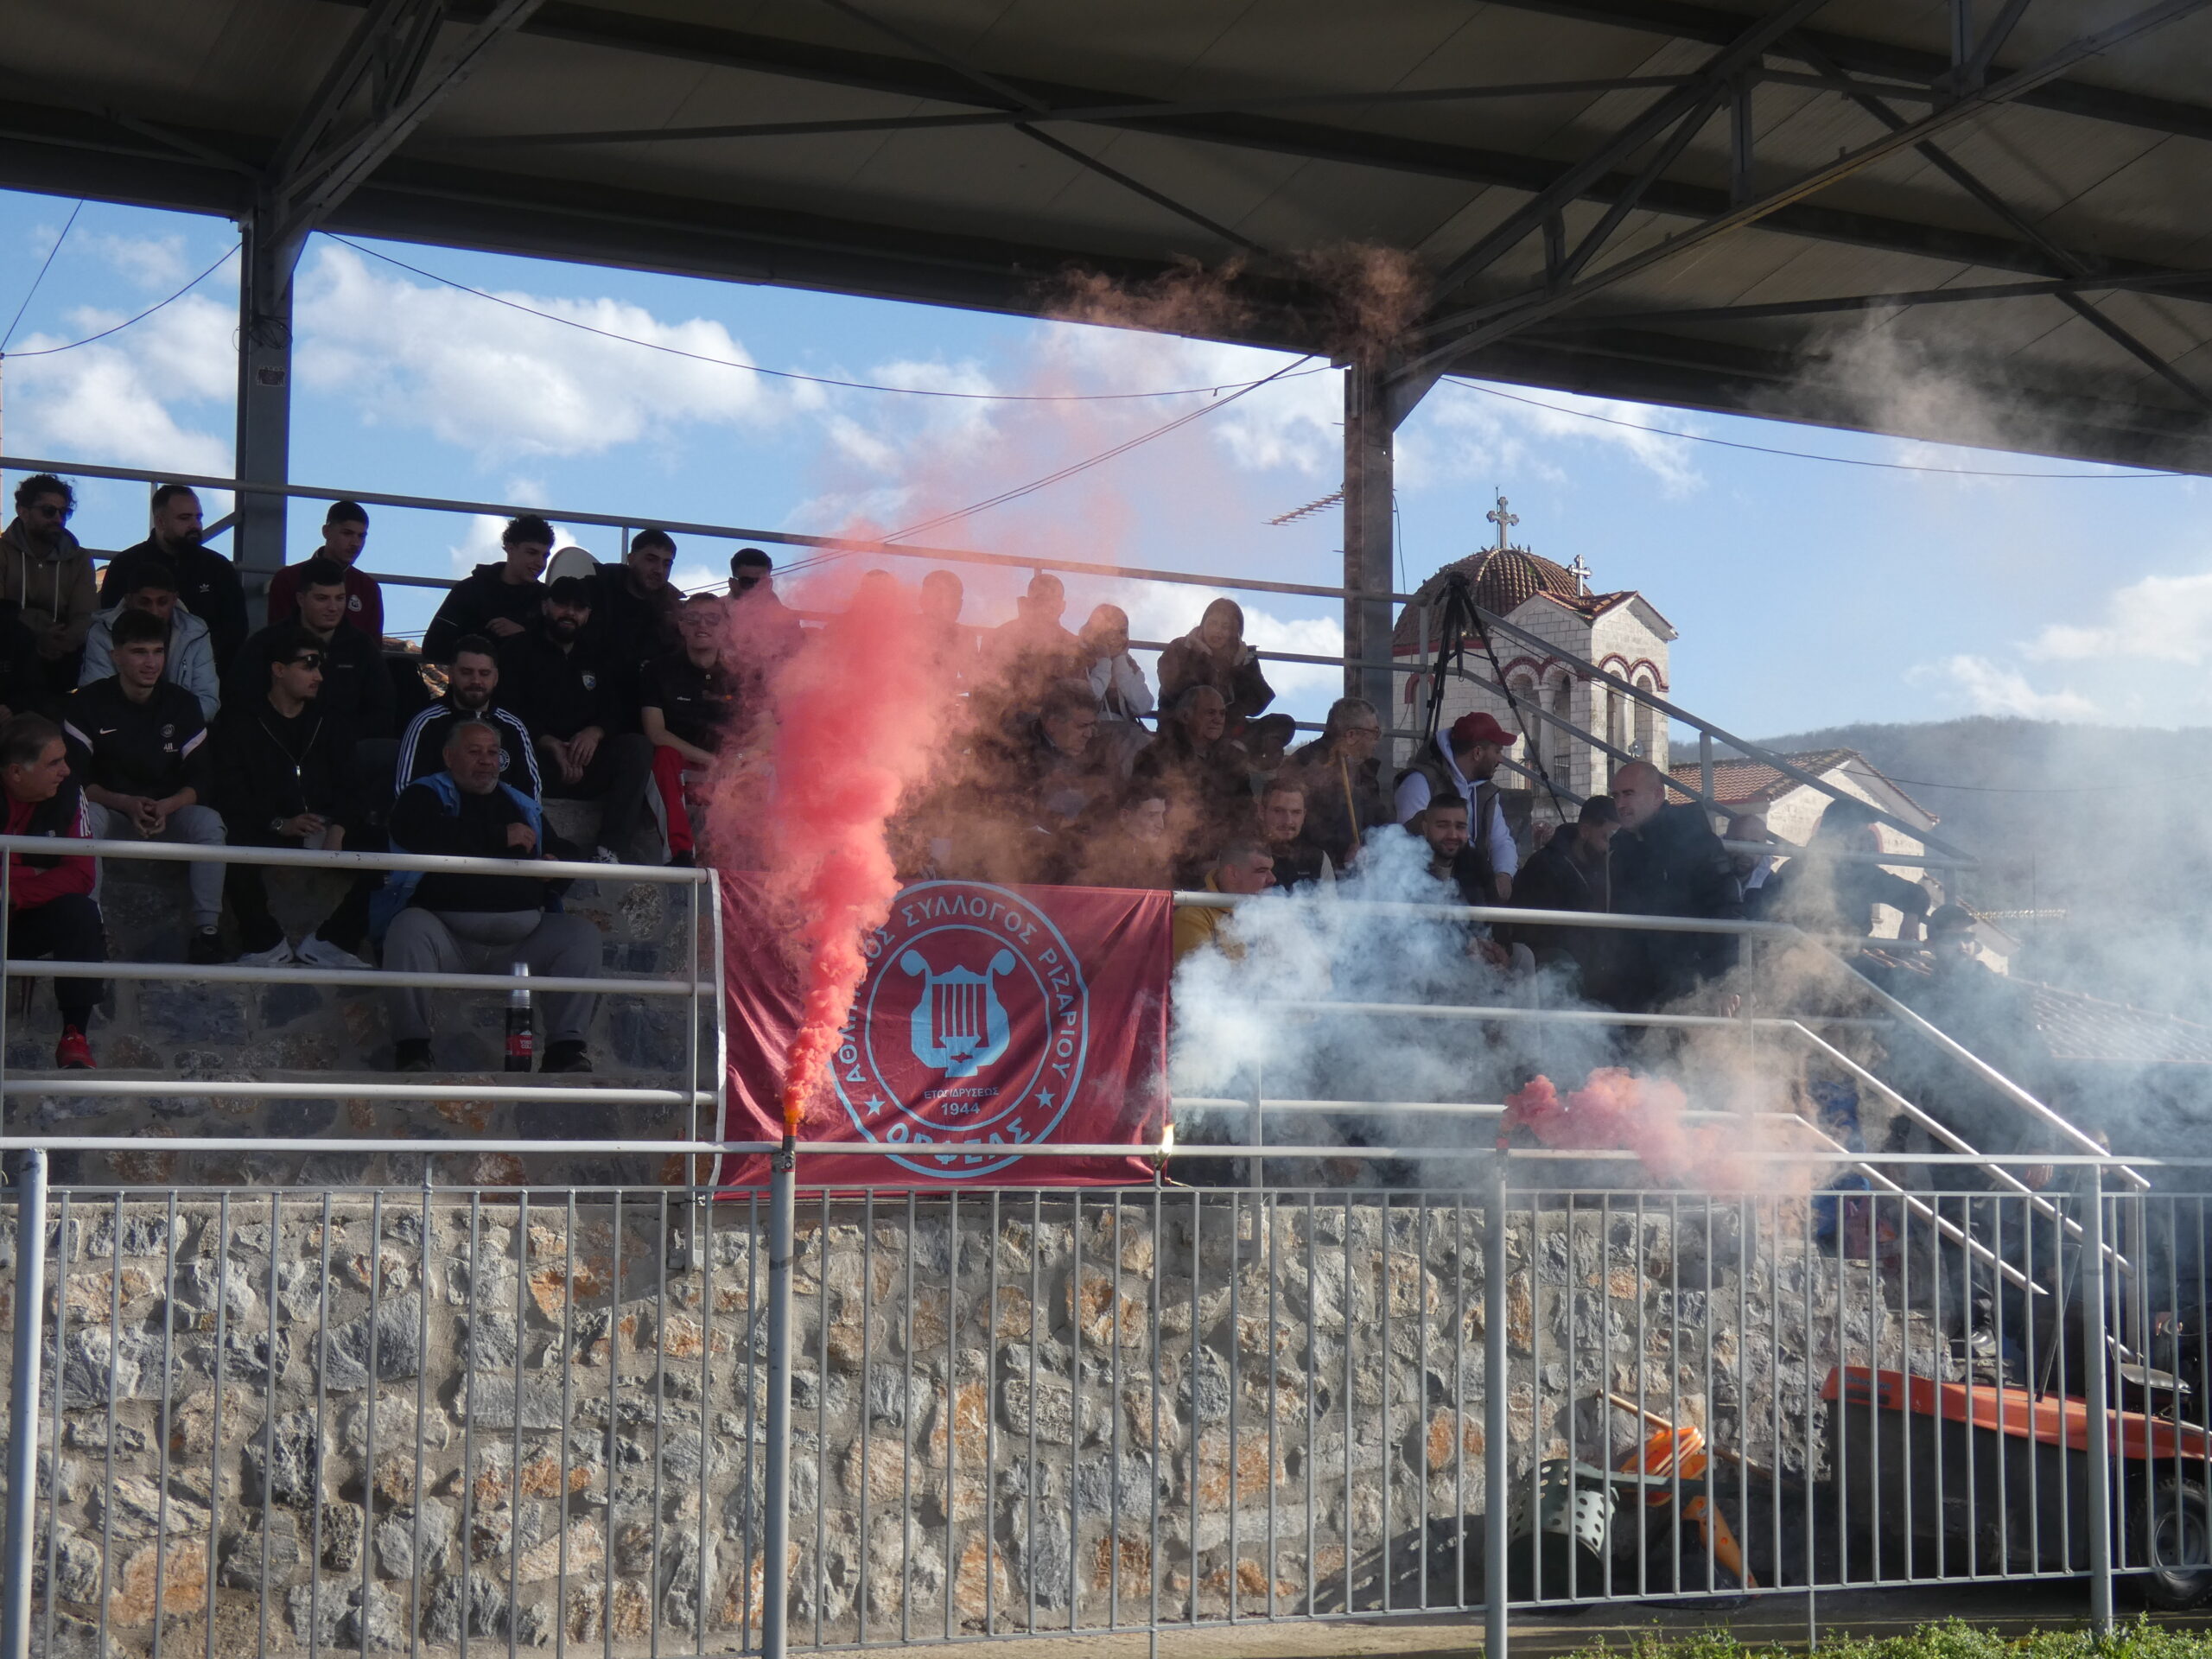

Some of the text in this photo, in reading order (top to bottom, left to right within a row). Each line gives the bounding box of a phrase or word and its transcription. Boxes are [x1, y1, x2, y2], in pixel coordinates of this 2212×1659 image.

[837, 894, 1077, 1082] ΑΘΛΟΣ ΣΥΛΛΟΓΟΣ ΡΙΖΑΡΙΟΥ
[950, 1086, 1000, 1097] ΙΔΡΥΣΕΩΣ
[941, 1102, 981, 1116] 1944
